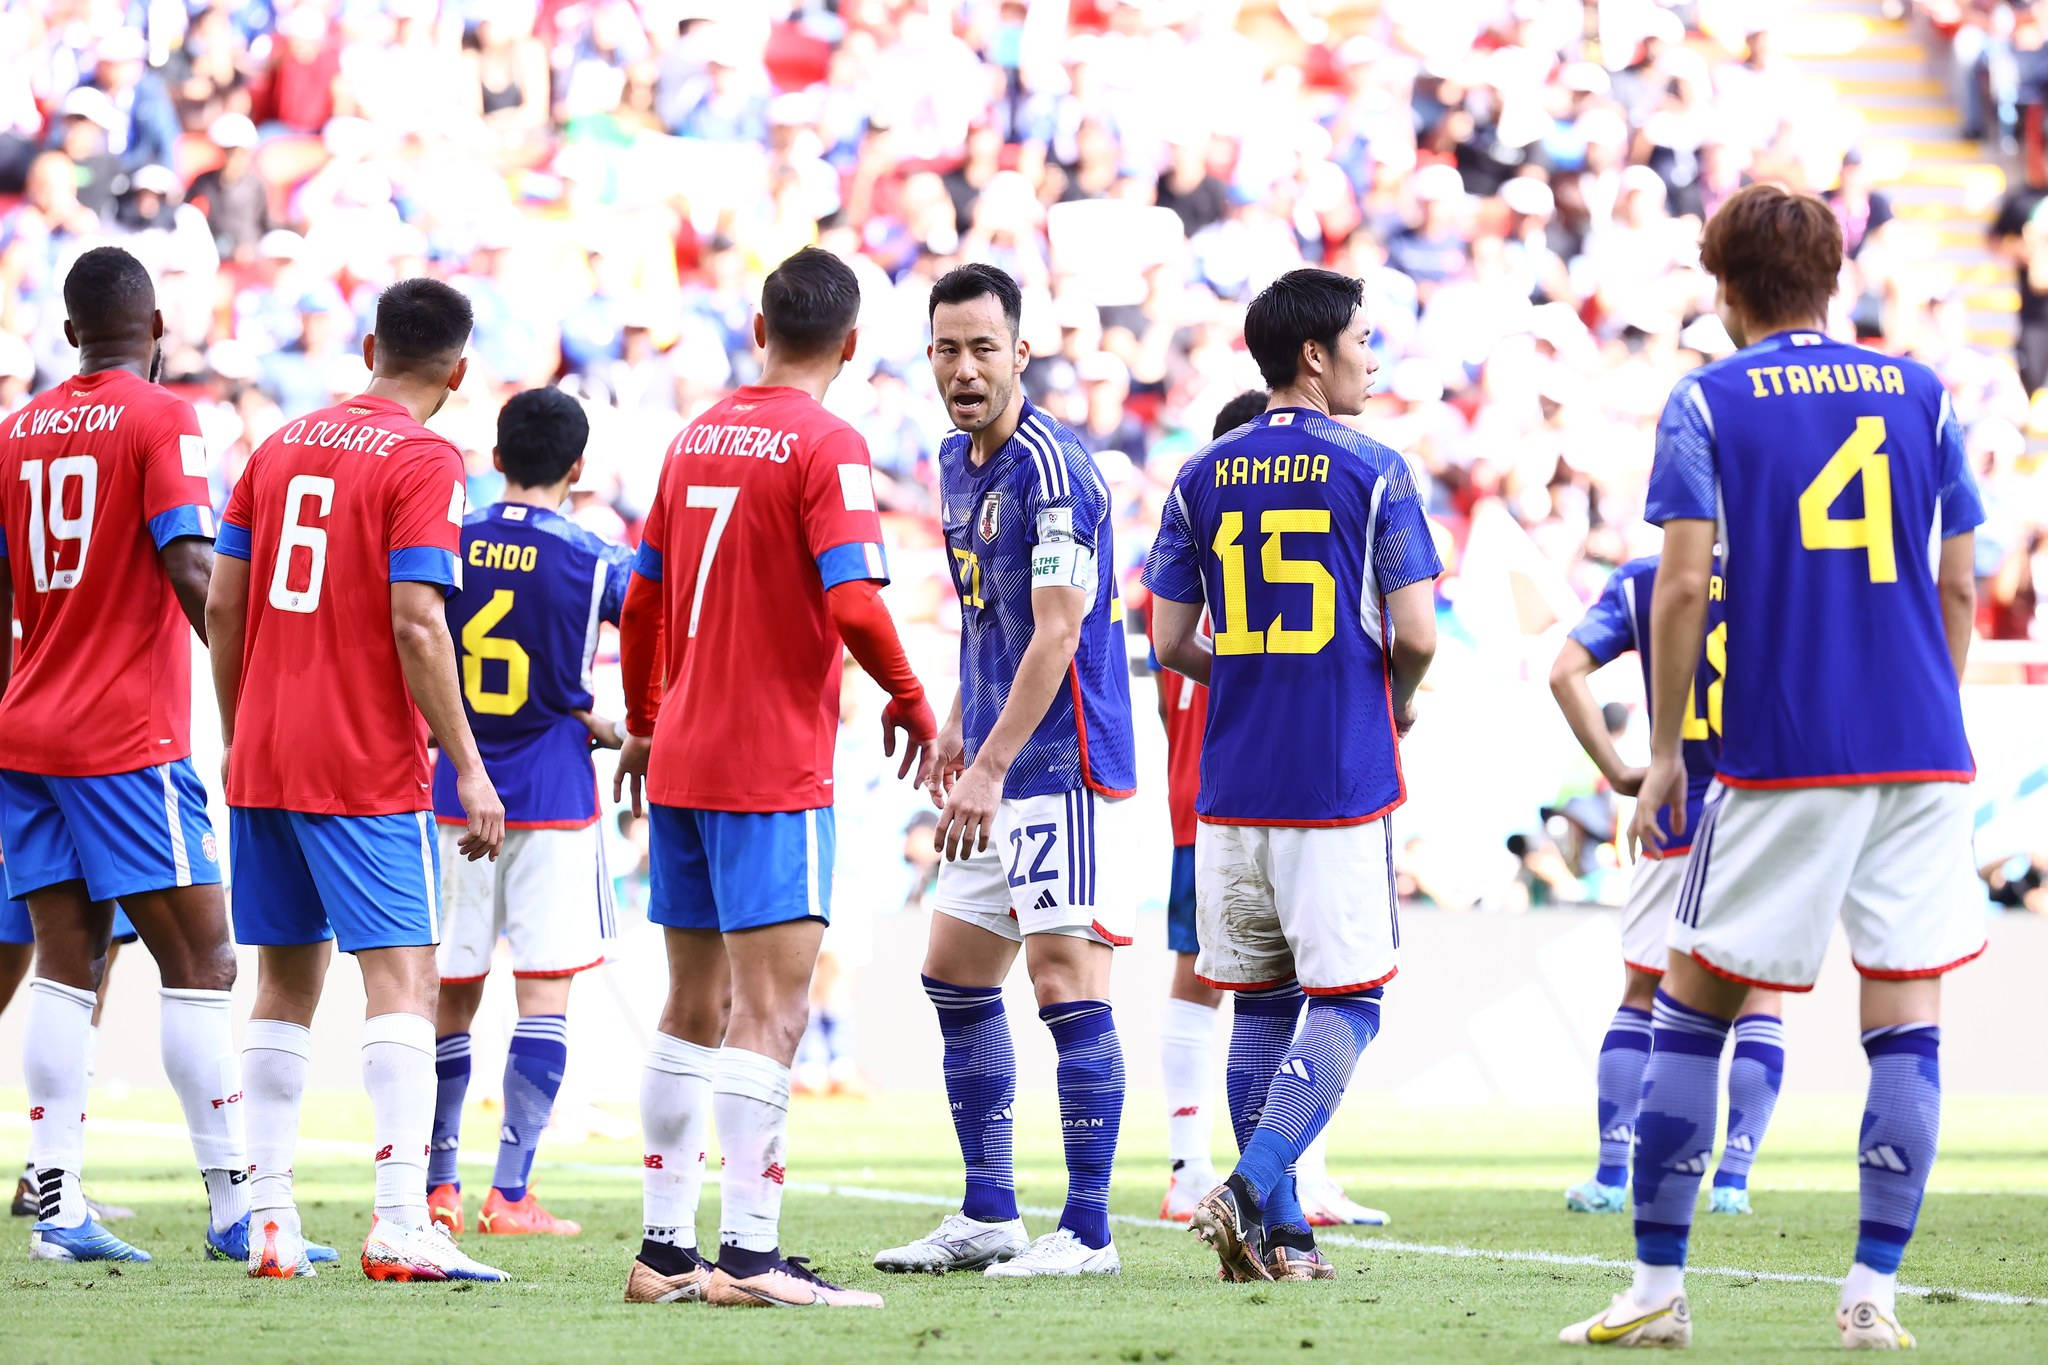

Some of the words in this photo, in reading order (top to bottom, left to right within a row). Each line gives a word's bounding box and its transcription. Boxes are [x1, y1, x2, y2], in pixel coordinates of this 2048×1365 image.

[1746, 363, 1906, 398] ITAKURA
[9, 411, 31, 440] K.
[30, 403, 126, 437] WASTON
[283, 419, 306, 445] O.
[303, 420, 405, 457] DUARTE
[685, 423, 799, 464] CONTRERAS
[1215, 454, 1331, 488] KAMADA
[1798, 415, 1899, 583] 4
[18, 454, 99, 593] 19
[269, 474, 336, 614] 6
[468, 539, 538, 573] ENDO
[685, 484, 741, 639] 7
[1039, 556, 1061, 565] THE
[1211, 509, 1337, 657] 15
[461, 589, 530, 716] 6
[1007, 822, 1059, 888] 22
[1061, 1117, 1104, 1128] PAN
